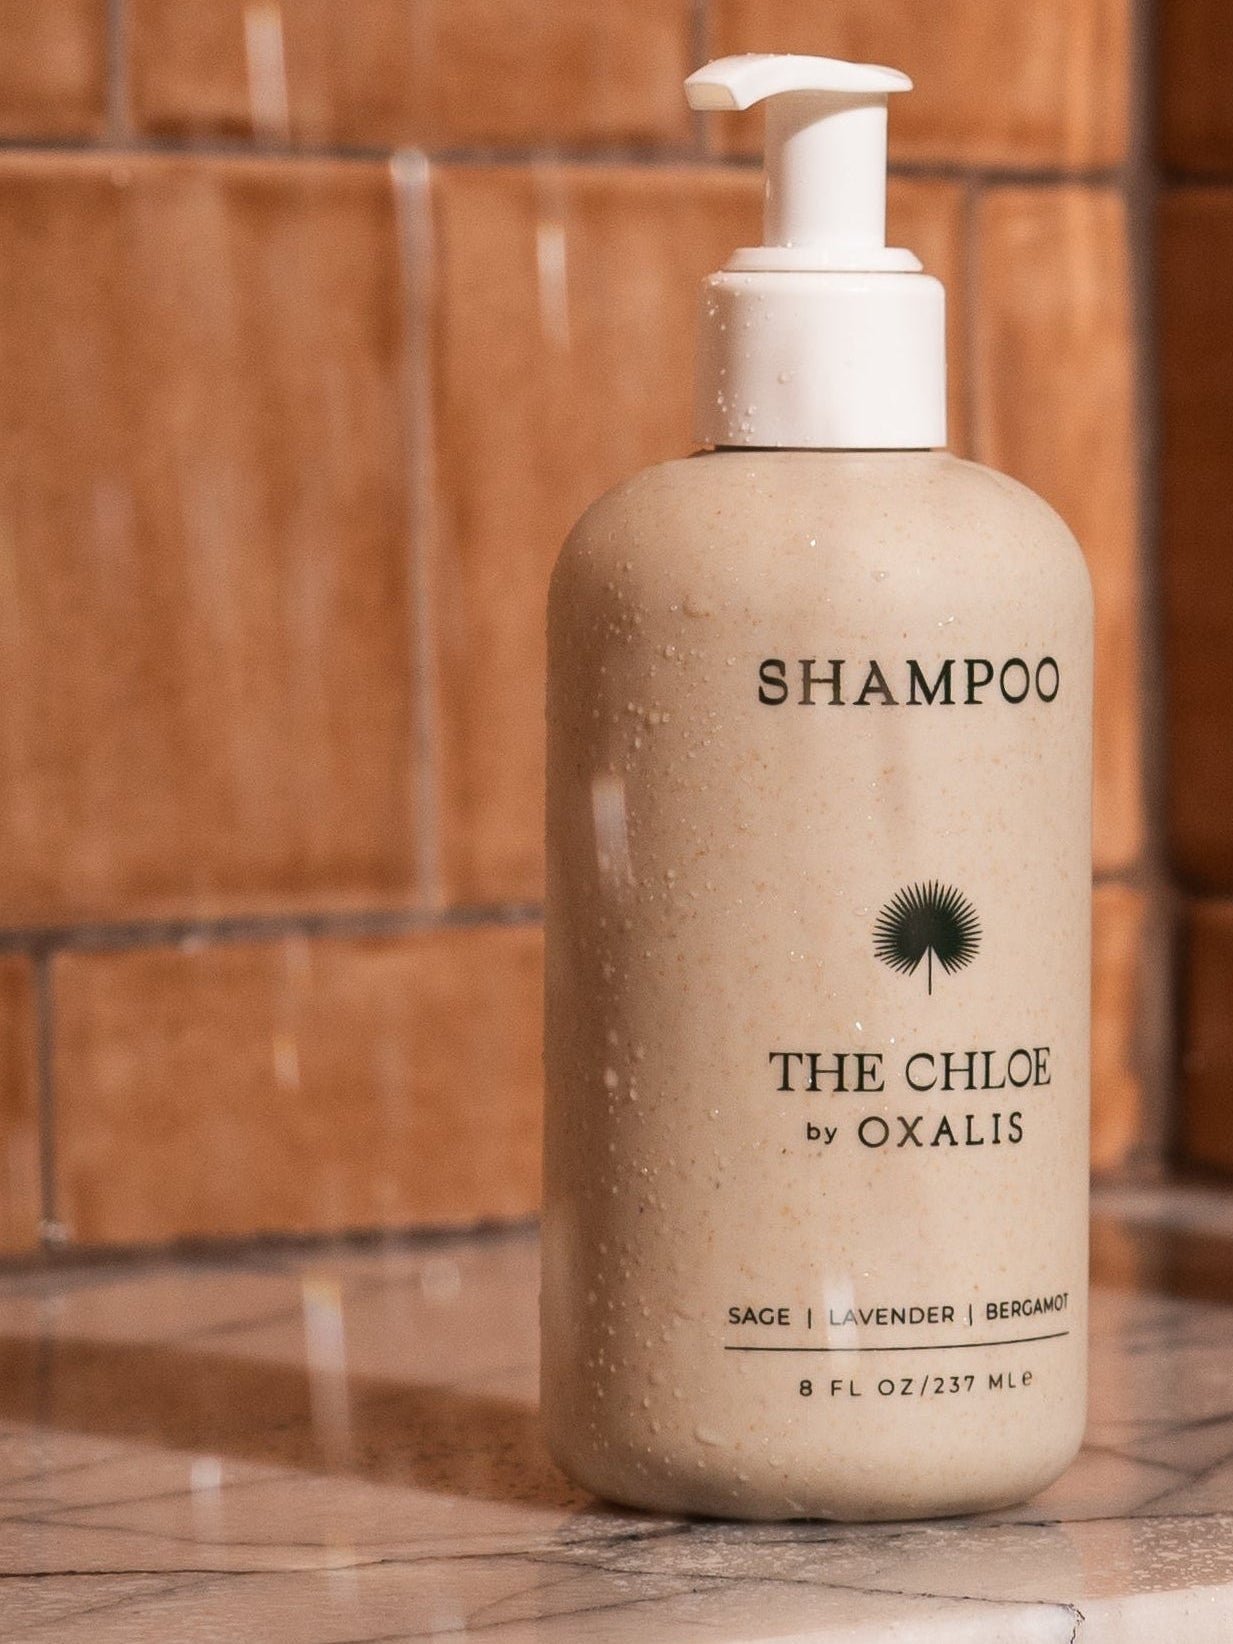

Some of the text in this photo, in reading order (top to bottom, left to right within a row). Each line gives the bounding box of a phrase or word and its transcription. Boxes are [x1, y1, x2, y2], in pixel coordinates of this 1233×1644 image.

[758, 656, 1060, 706] SHAMPOO
[769, 1046, 1051, 1092] THE CHLOE
[807, 1112, 1023, 1148] by OXALIS
[728, 1293, 1070, 1327] SAGE LAVENDER BERGAMOT
[799, 1380, 813, 1397] 8
[831, 1379, 862, 1397] FL
[878, 1375, 976, 1397] OZ/237
